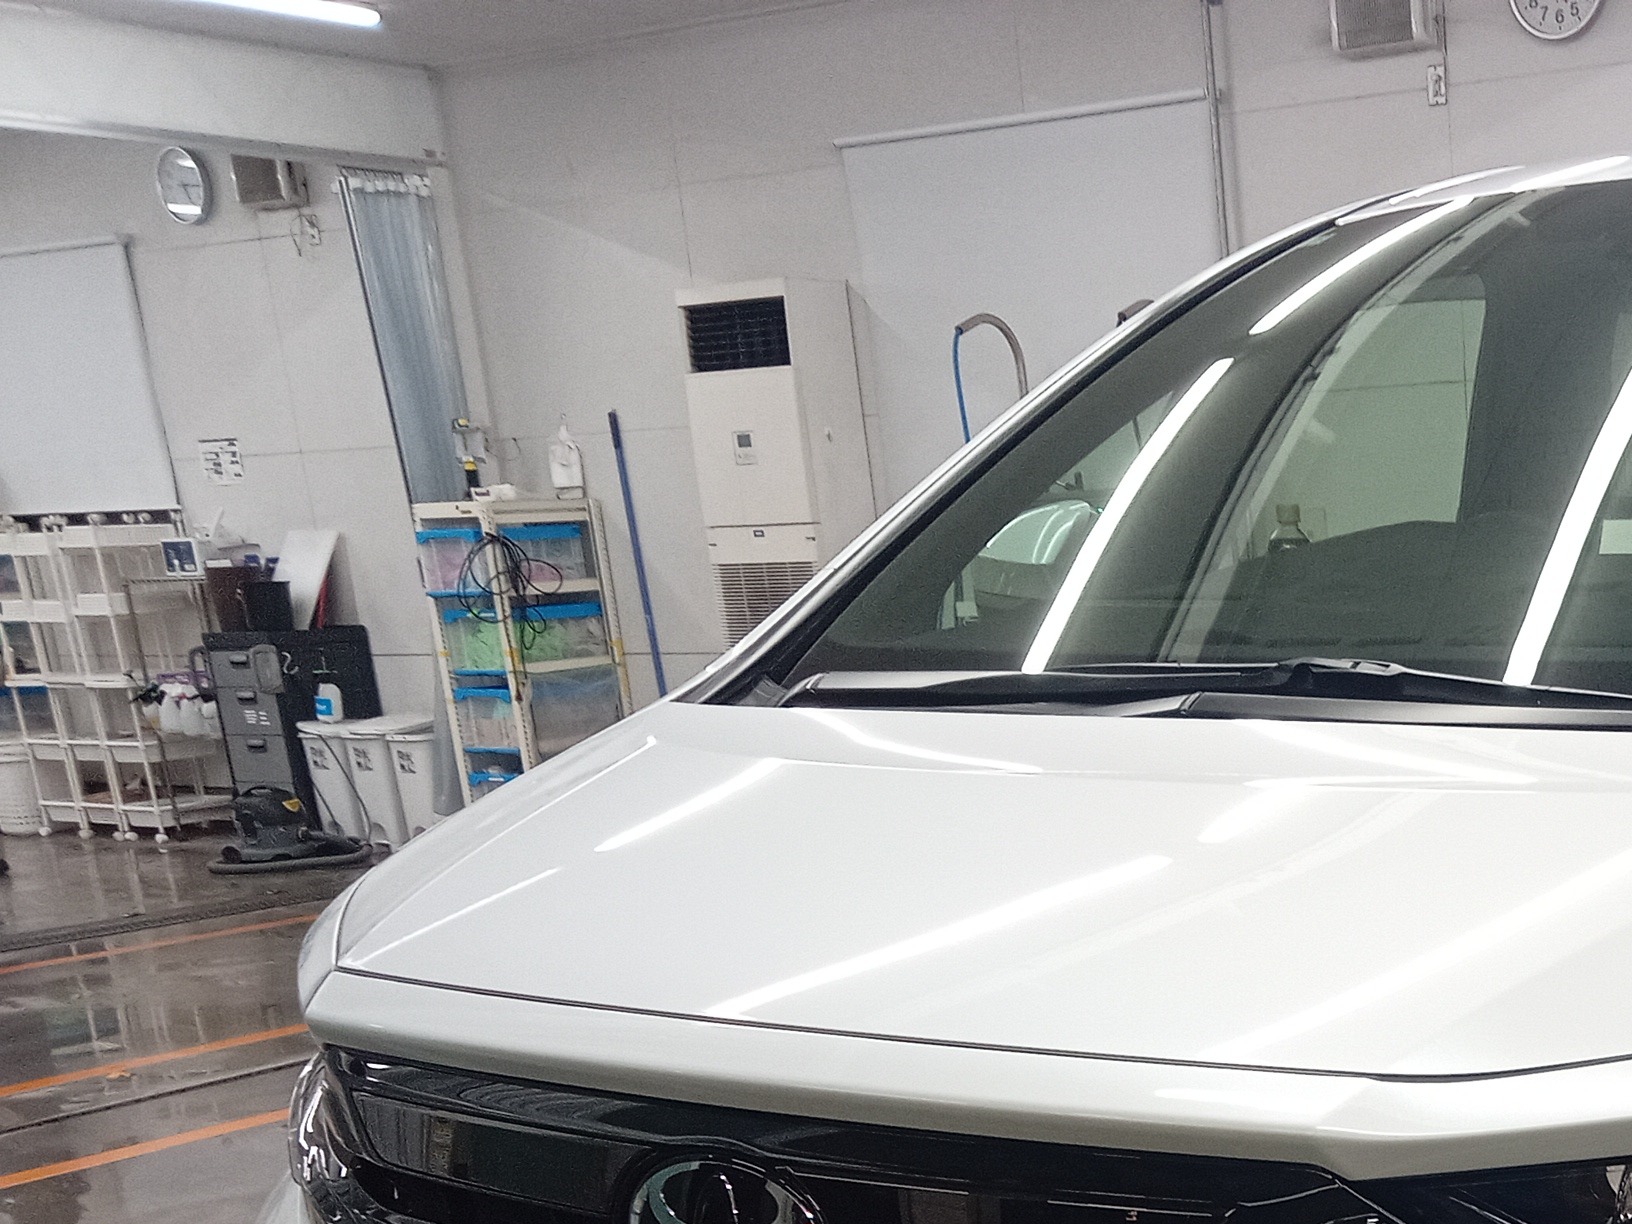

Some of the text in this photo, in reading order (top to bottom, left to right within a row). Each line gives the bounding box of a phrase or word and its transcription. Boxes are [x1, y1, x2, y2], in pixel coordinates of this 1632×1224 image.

[1540, 6, 1548, 21] 7
[1555, 9, 1564, 24] 6
[1570, 2, 1579, 17] 5
